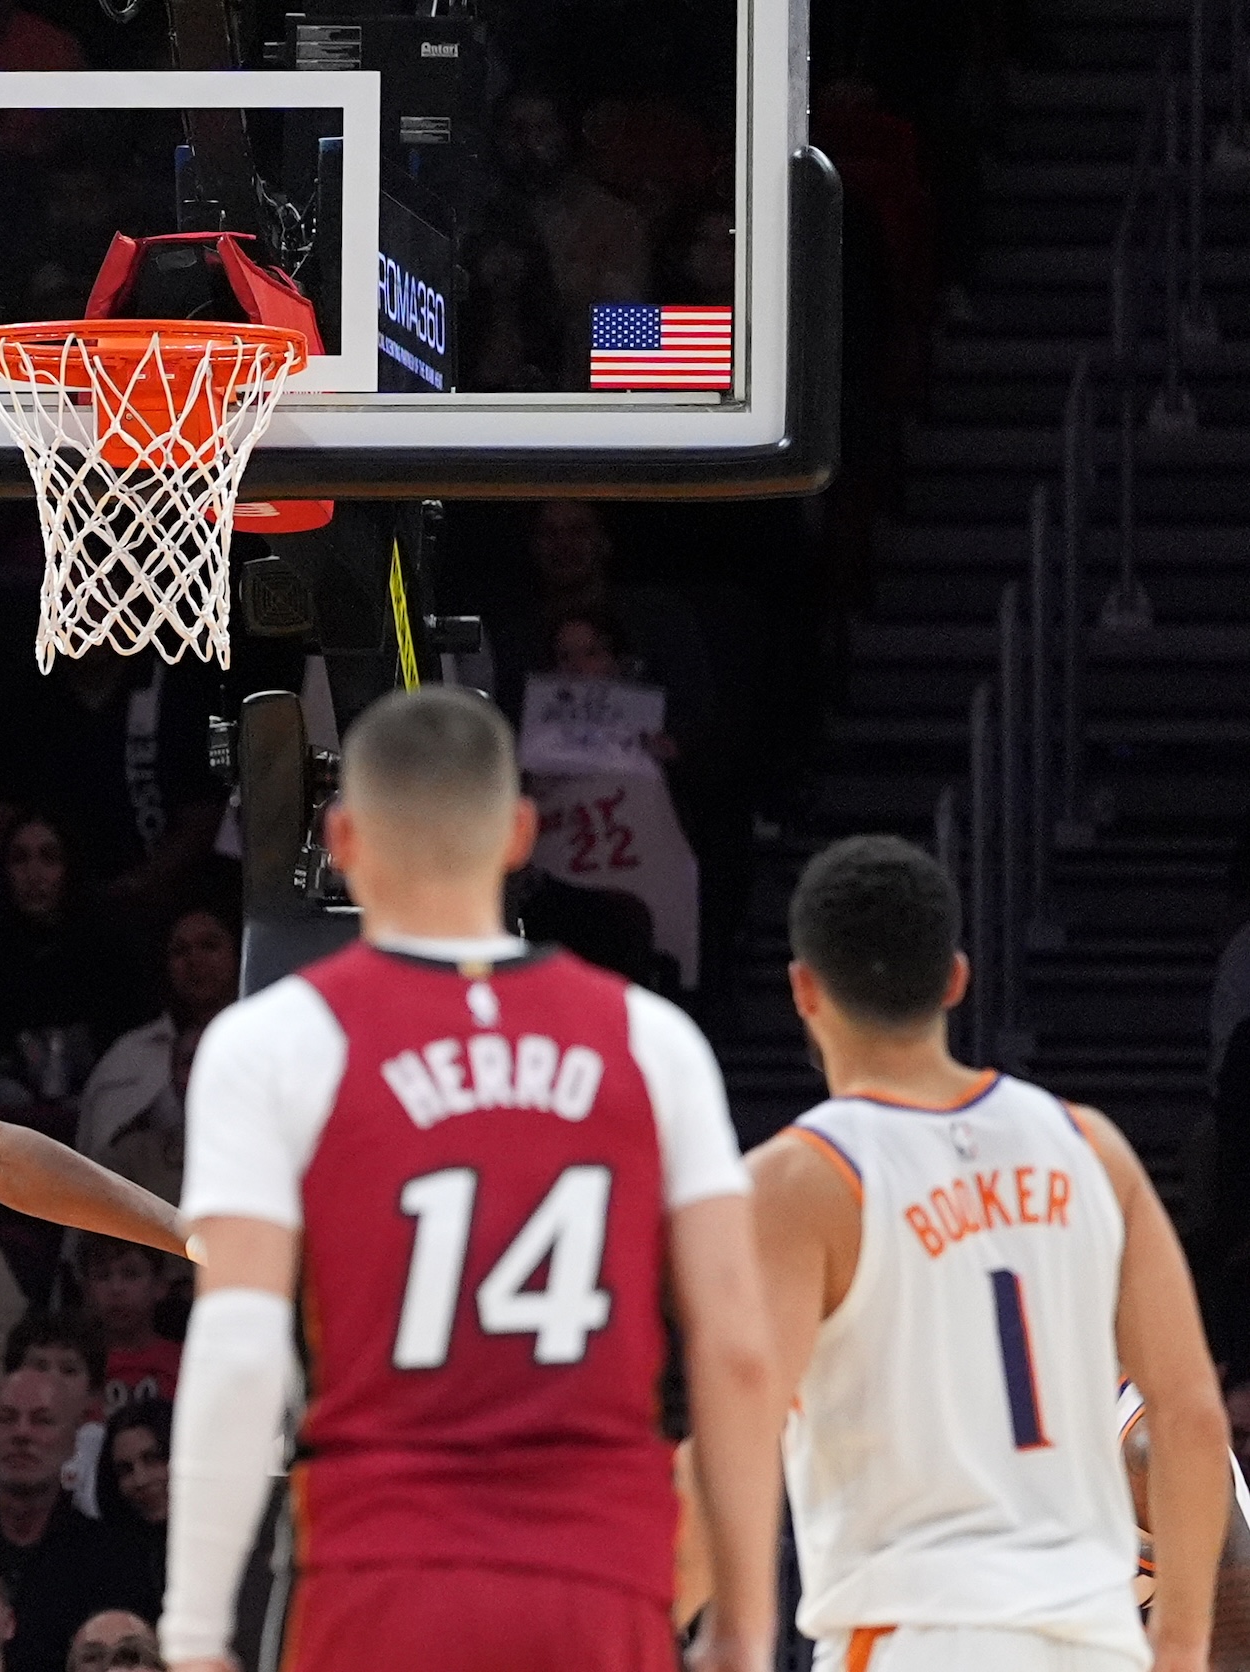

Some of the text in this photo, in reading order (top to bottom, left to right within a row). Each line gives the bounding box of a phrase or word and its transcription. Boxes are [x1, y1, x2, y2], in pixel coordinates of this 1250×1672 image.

[380, 1033, 604, 1130] HERRO
[392, 1164, 612, 1370] 14
[988, 1266, 1053, 1452] 1
